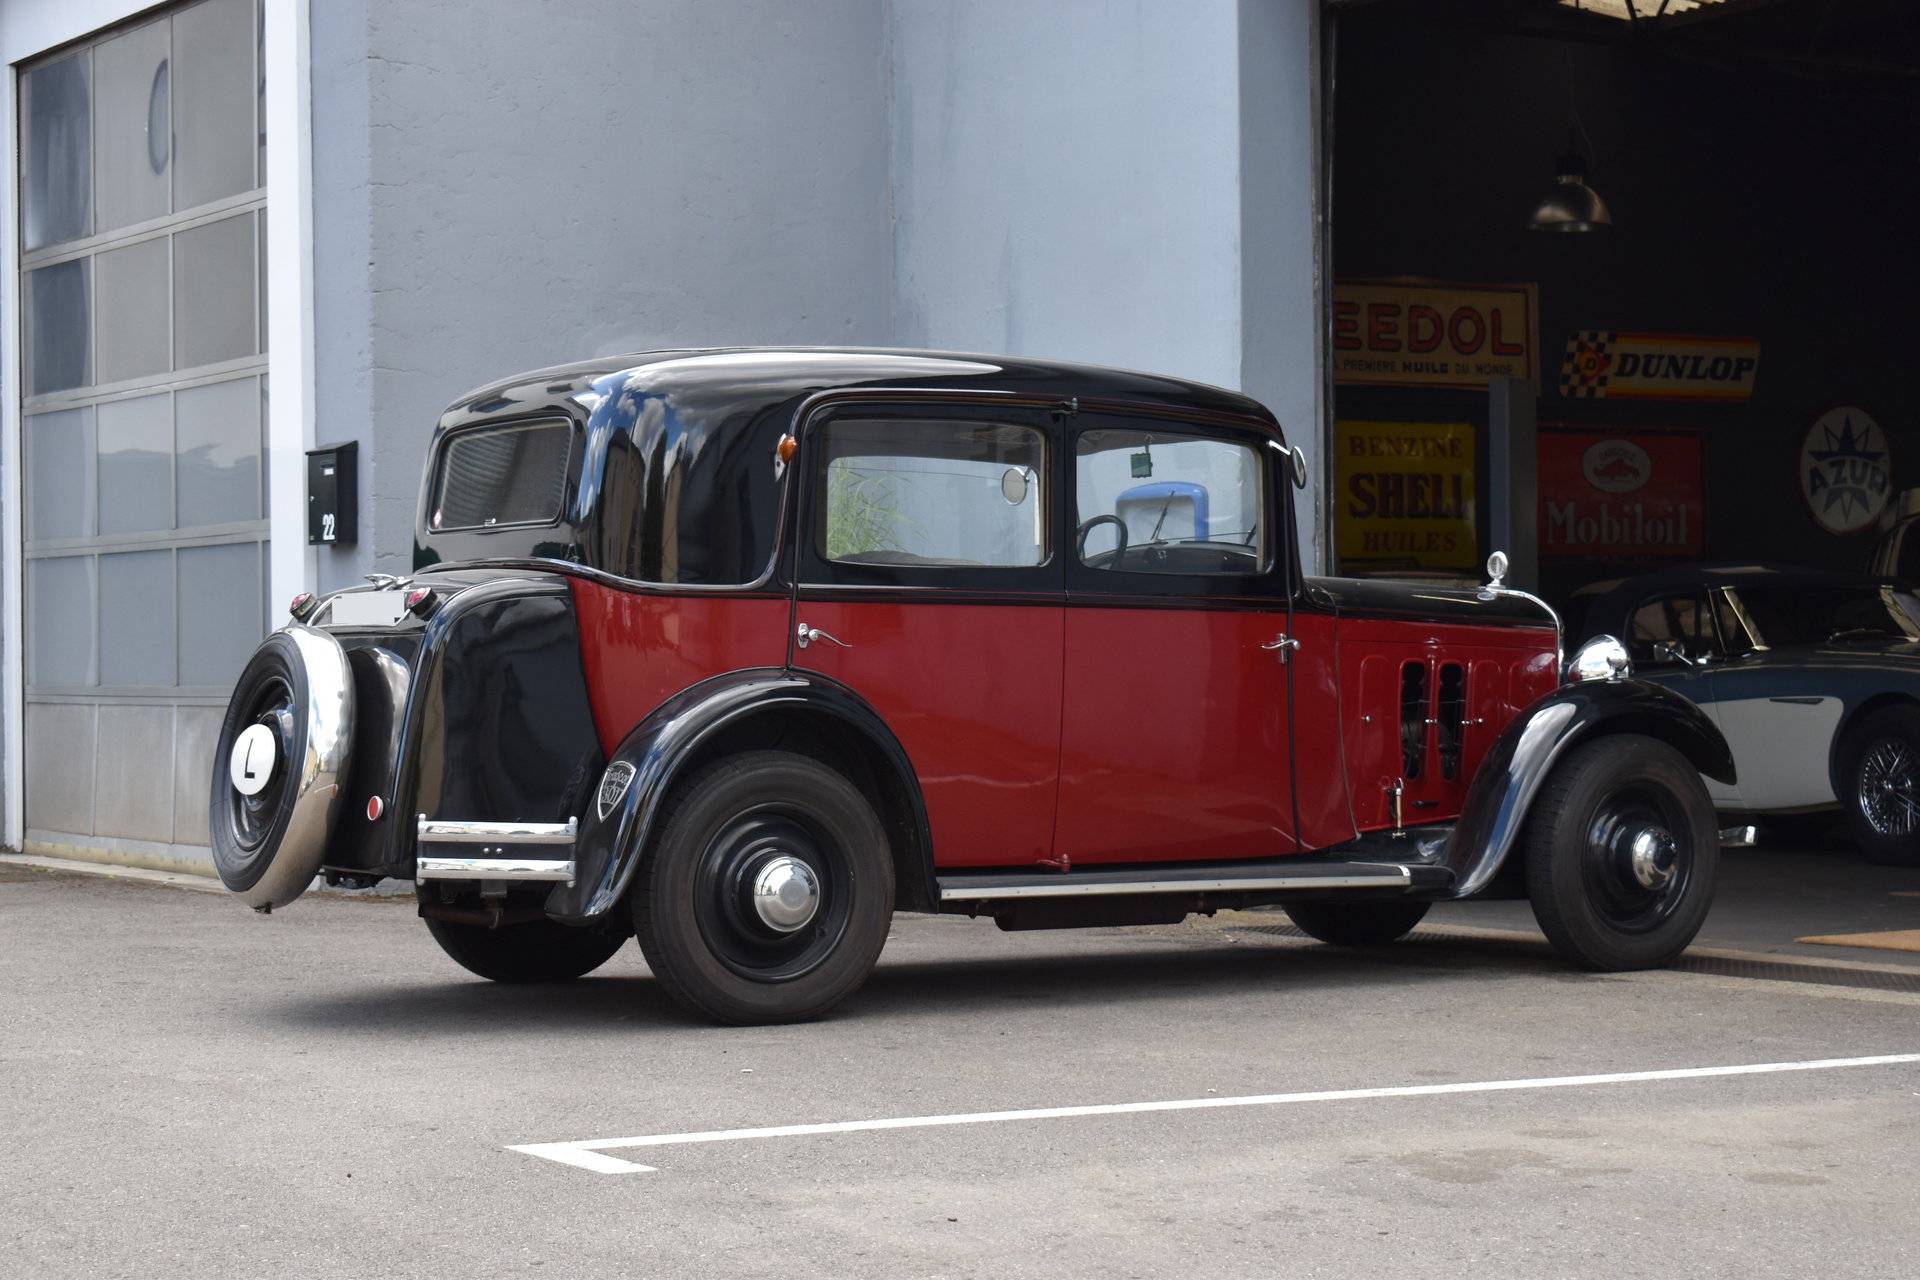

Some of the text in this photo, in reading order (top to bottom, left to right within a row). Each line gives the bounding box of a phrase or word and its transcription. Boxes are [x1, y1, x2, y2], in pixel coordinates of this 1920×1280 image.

[1402, 361, 1449, 374] HUILE
[1454, 362, 1470, 375] DU
[1475, 363, 1514, 377] MONDE
[1613, 352, 1756, 381] DUNLOP
[1349, 435, 1463, 458] BENZINE
[1809, 459, 1889, 498] AZUR
[1348, 472, 1468, 520] SHELL
[322, 513, 336, 541] 22
[1545, 501, 1688, 545] Mobiloil
[1361, 531, 1458, 552] HUILES
[244, 737, 256, 779] L
[601, 786, 620, 805] 301
